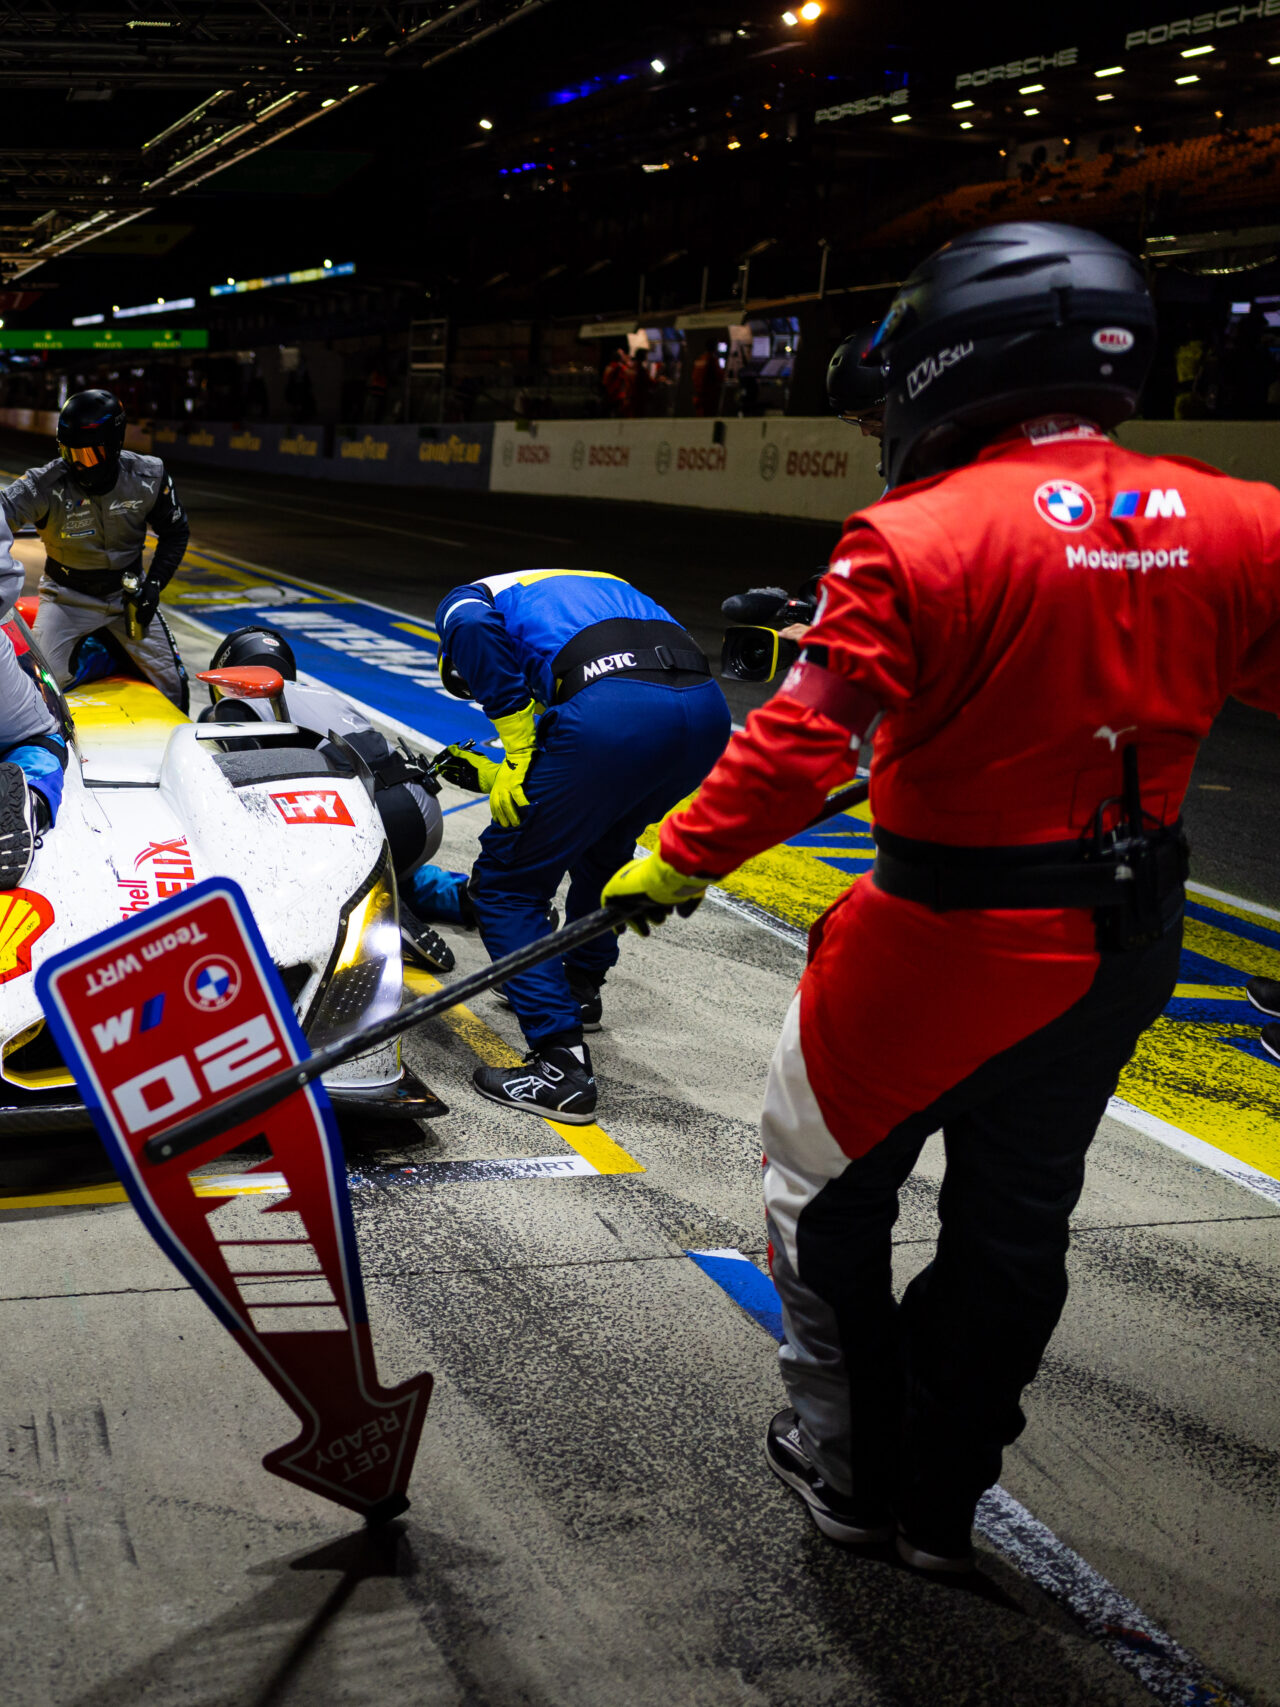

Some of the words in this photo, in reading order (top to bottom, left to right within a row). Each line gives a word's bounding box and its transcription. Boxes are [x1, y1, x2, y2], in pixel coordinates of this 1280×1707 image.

[1123, 0, 1280, 51] PORSCHE
[954, 45, 1080, 91] PORSCHE
[814, 87, 910, 126] PORSCHE
[1098, 334, 1129, 345] BELL
[418, 434, 481, 465] GOODYEAR
[516, 445, 550, 464] BOSCH
[588, 446, 629, 467] BOSCH
[677, 447, 728, 471] BOSCH
[785, 450, 848, 478] BOSCH
[1065, 544, 1190, 575] Motorsport
[583, 652, 638, 682] MRTC
[133, 834, 197, 905] ELIX
[142, 922, 208, 962] Team
[86, 953, 143, 997] WRT
[520, 1161, 575, 1174] WRT
[314, 1410, 401, 1472] READY
[342, 1442, 391, 1483] GET
